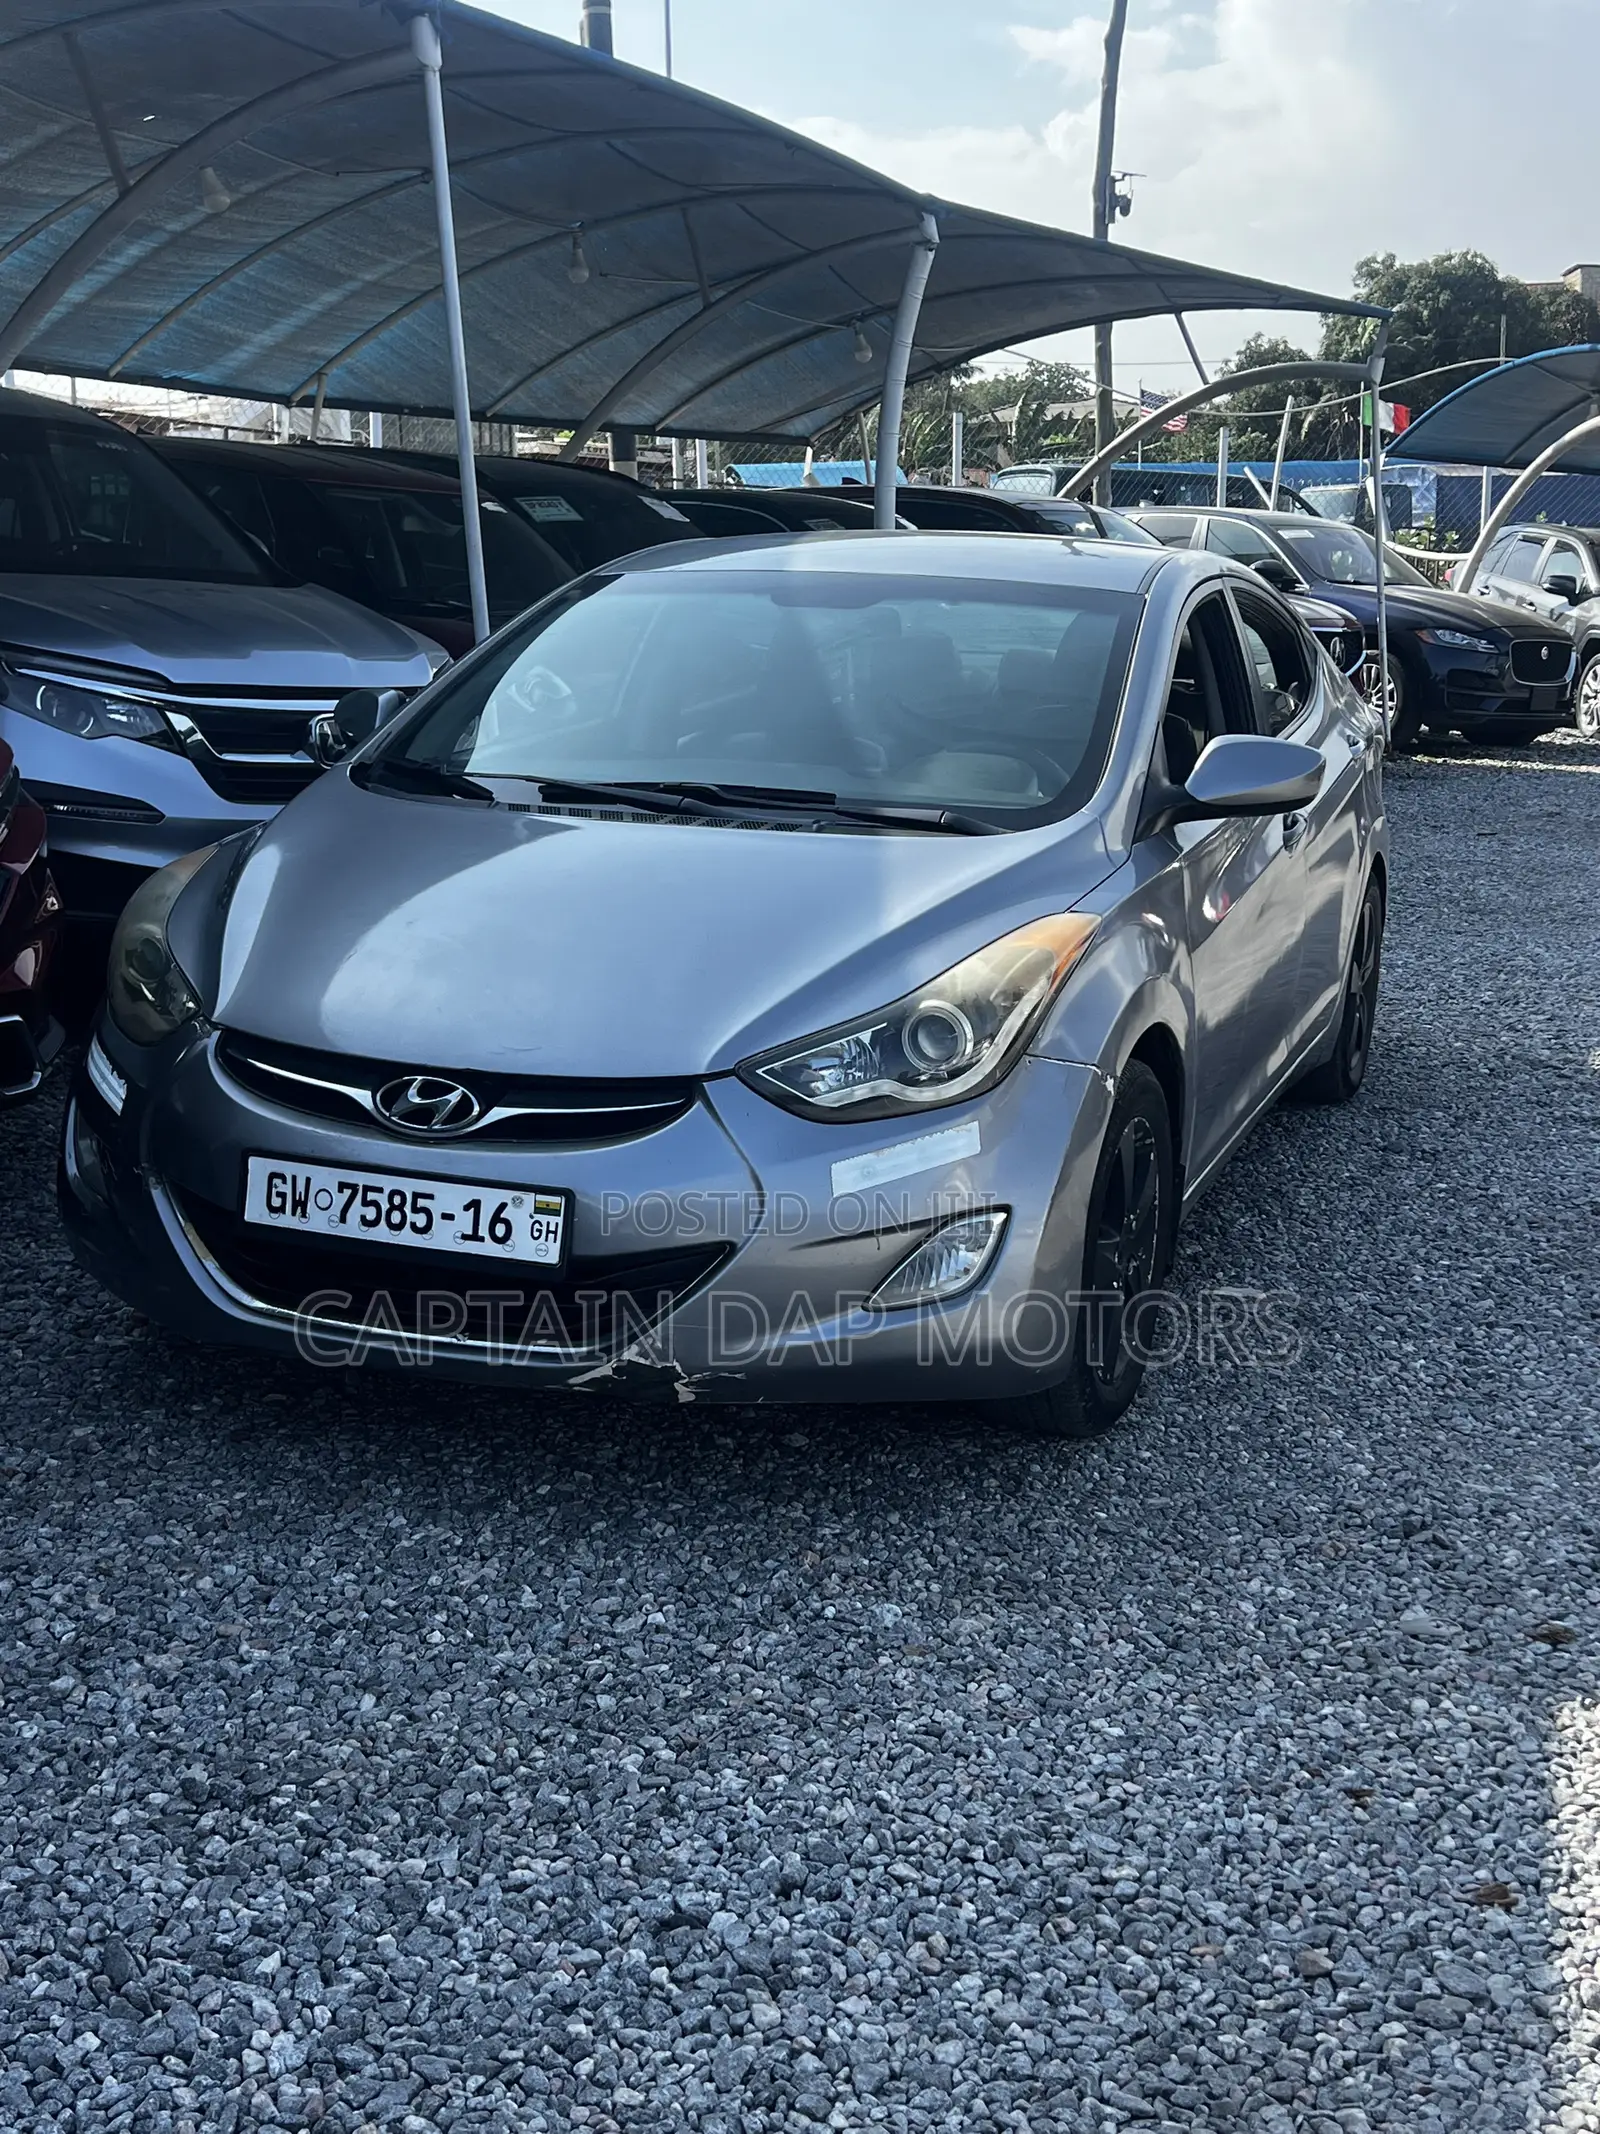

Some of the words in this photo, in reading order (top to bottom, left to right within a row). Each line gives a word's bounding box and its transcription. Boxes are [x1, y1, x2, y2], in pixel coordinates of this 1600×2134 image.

[265, 1172, 312, 1220] GW
[336, 1181, 514, 1246] 7585-16
[530, 1219, 559, 1244] GH
